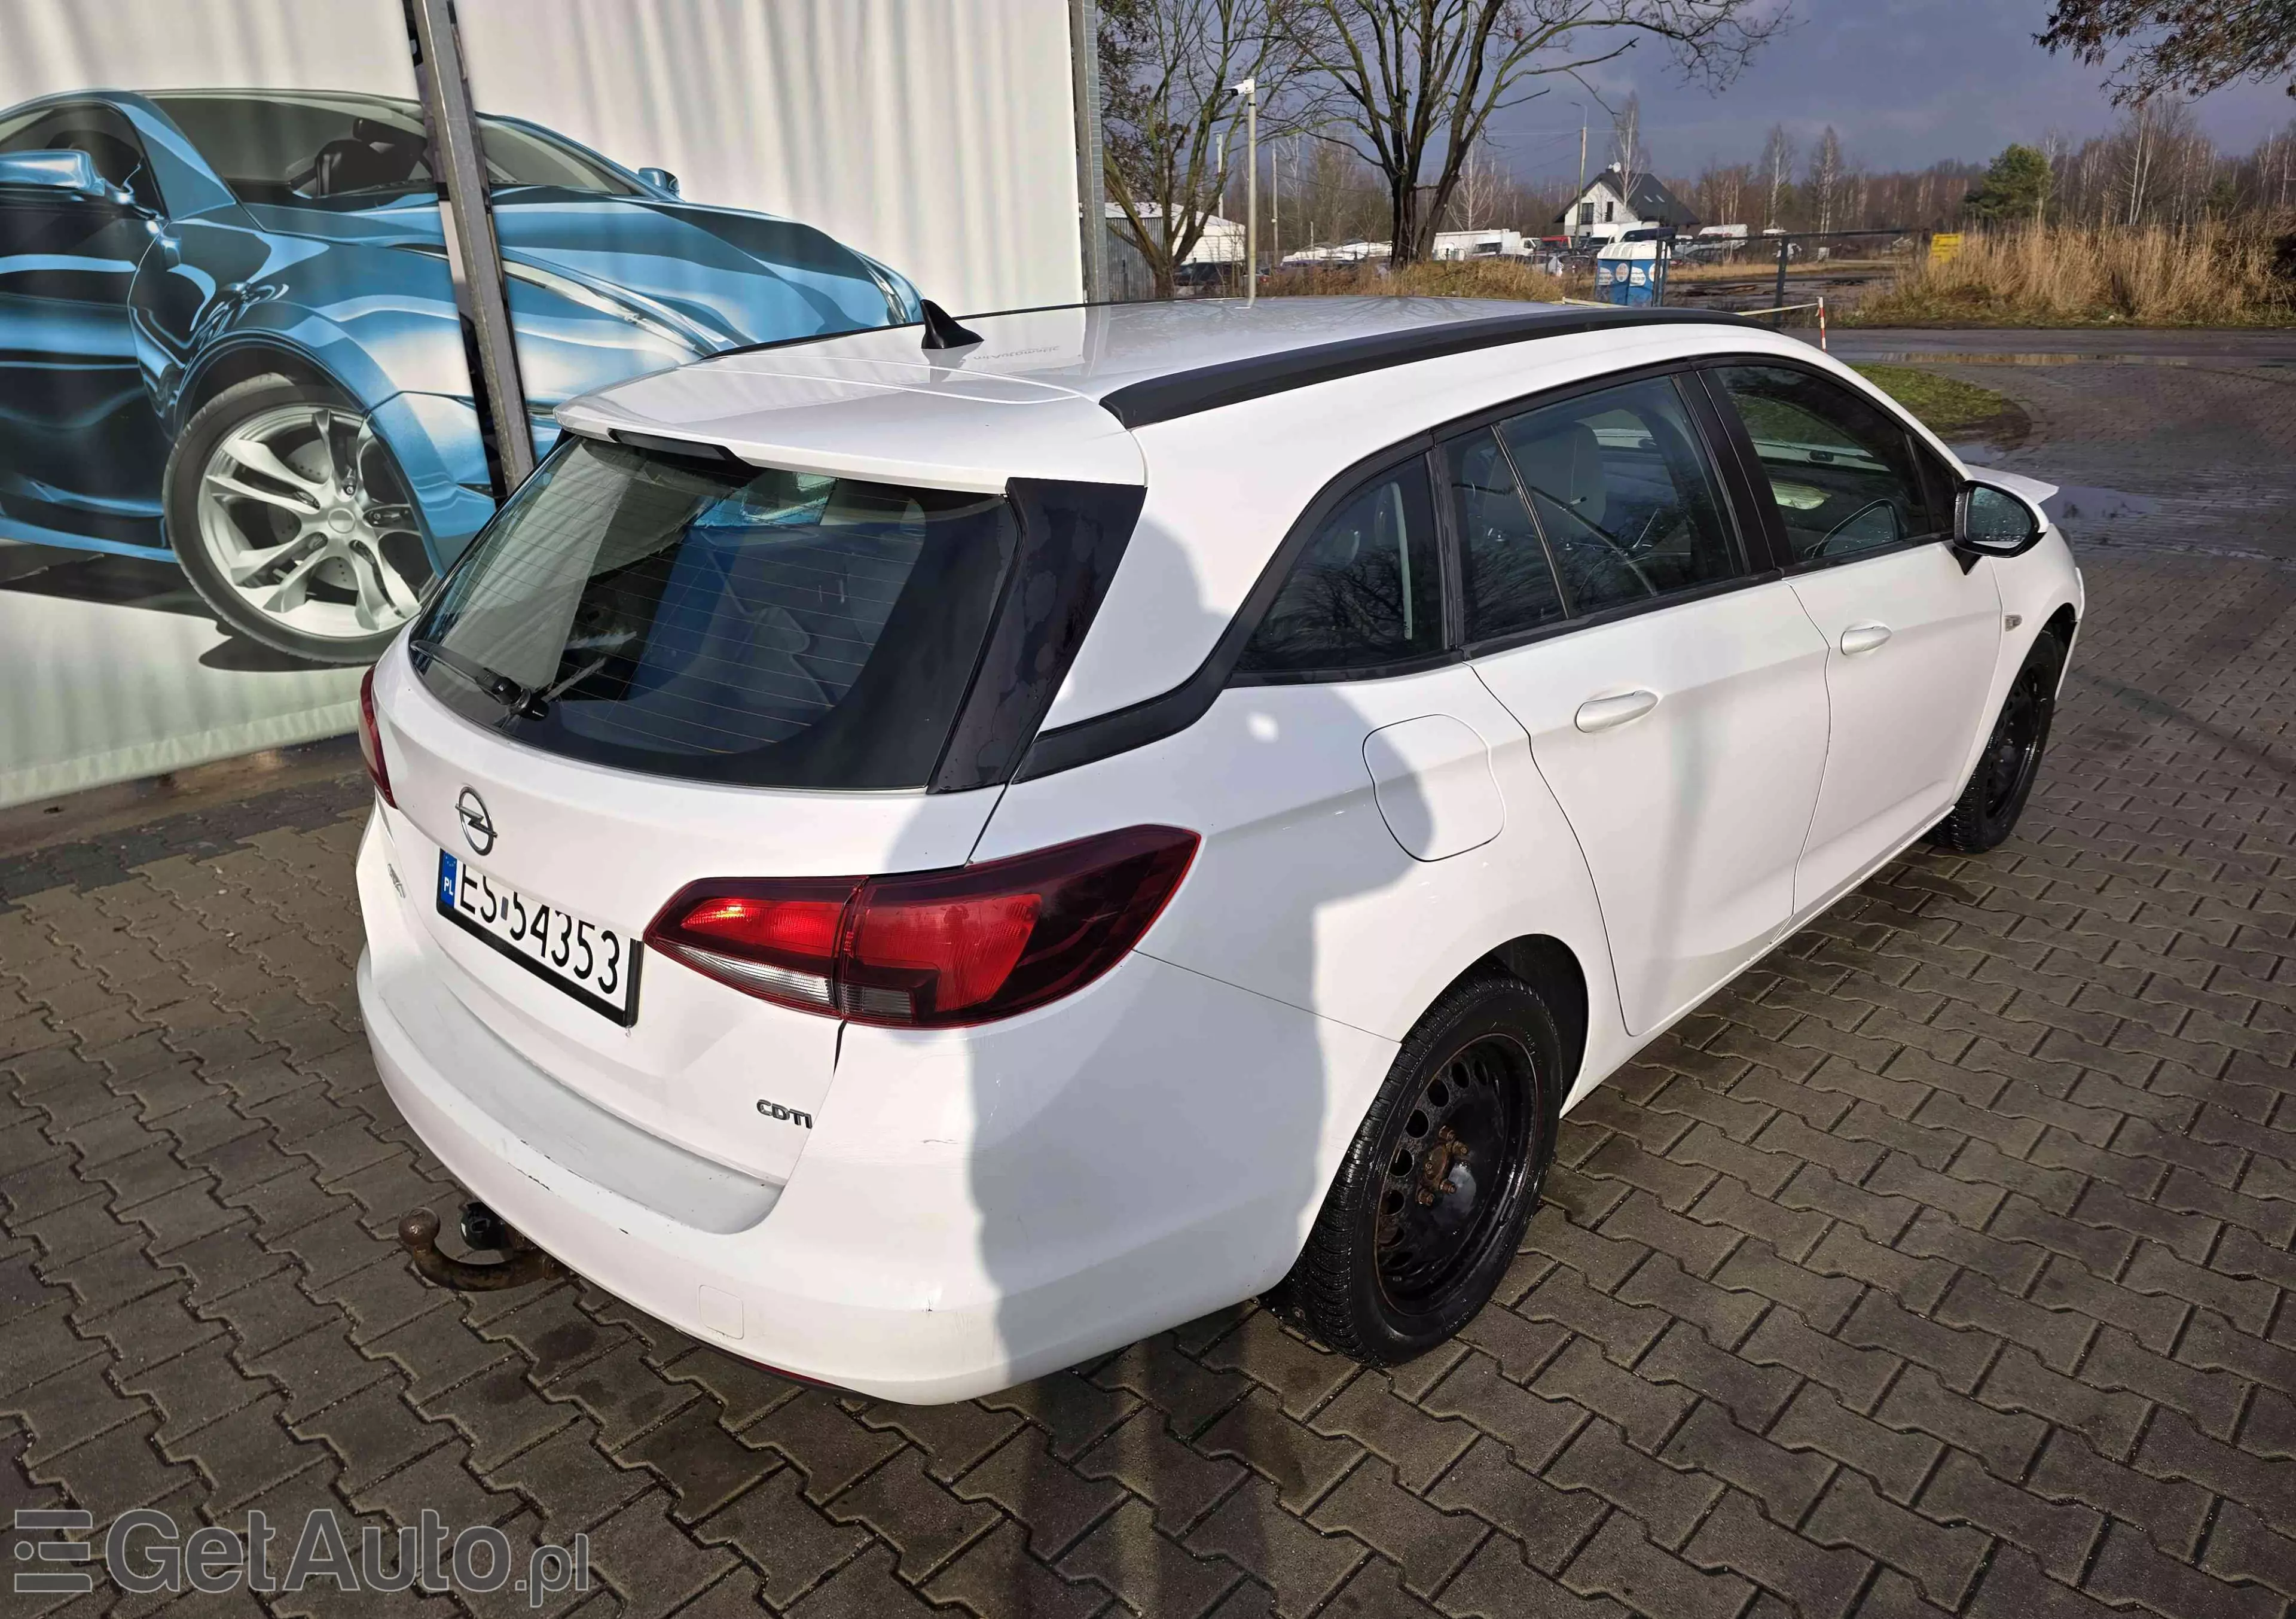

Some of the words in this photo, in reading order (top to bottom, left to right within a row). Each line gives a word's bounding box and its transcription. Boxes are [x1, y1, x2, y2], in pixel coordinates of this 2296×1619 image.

[444, 877, 454, 896] PL
[460, 863, 497, 923] ES
[509, 891, 620, 995] 54353
[756, 1099, 813, 1129] CDTI
